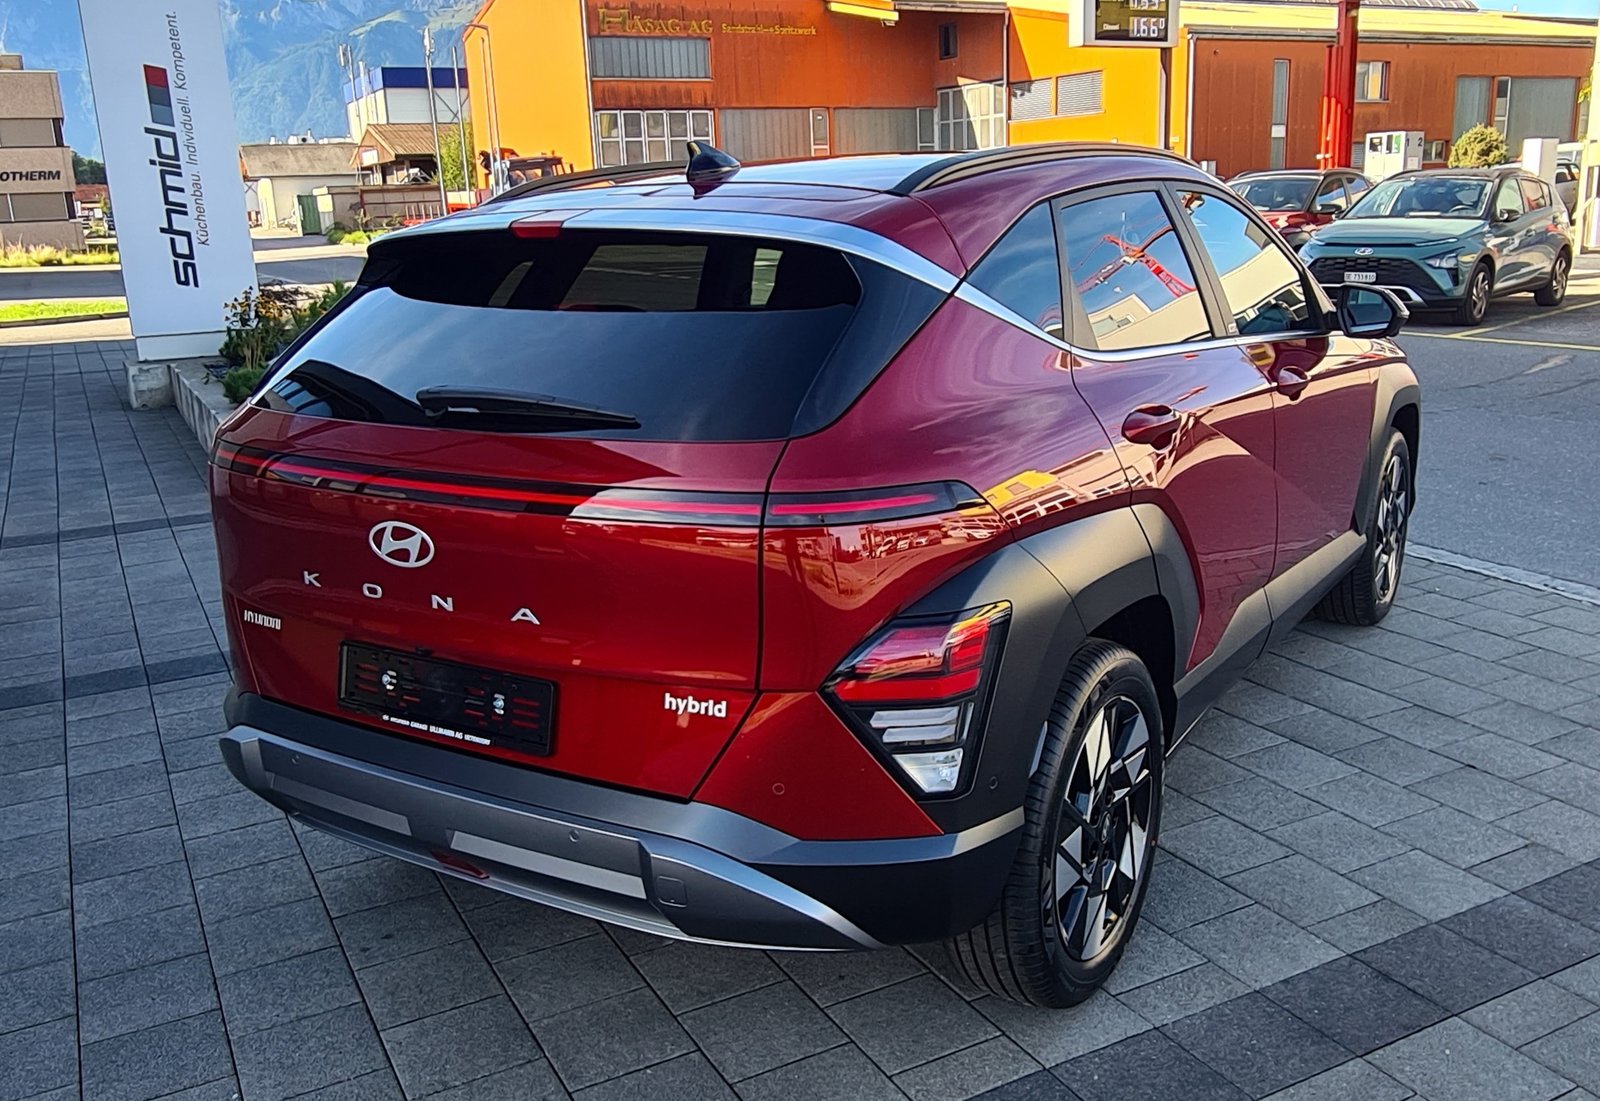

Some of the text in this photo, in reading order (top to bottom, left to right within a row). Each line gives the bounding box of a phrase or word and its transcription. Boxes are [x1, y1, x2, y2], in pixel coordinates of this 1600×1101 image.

[688, 19, 713, 34] AG
[167, 11, 210, 247] Küchenbau. Individuell. Kompetent.
[1417, 136, 1424, 147] 2
[0, 170, 61, 182] OTHERM
[144, 126, 200, 288] schmid
[664, 692, 727, 718] hybrid
